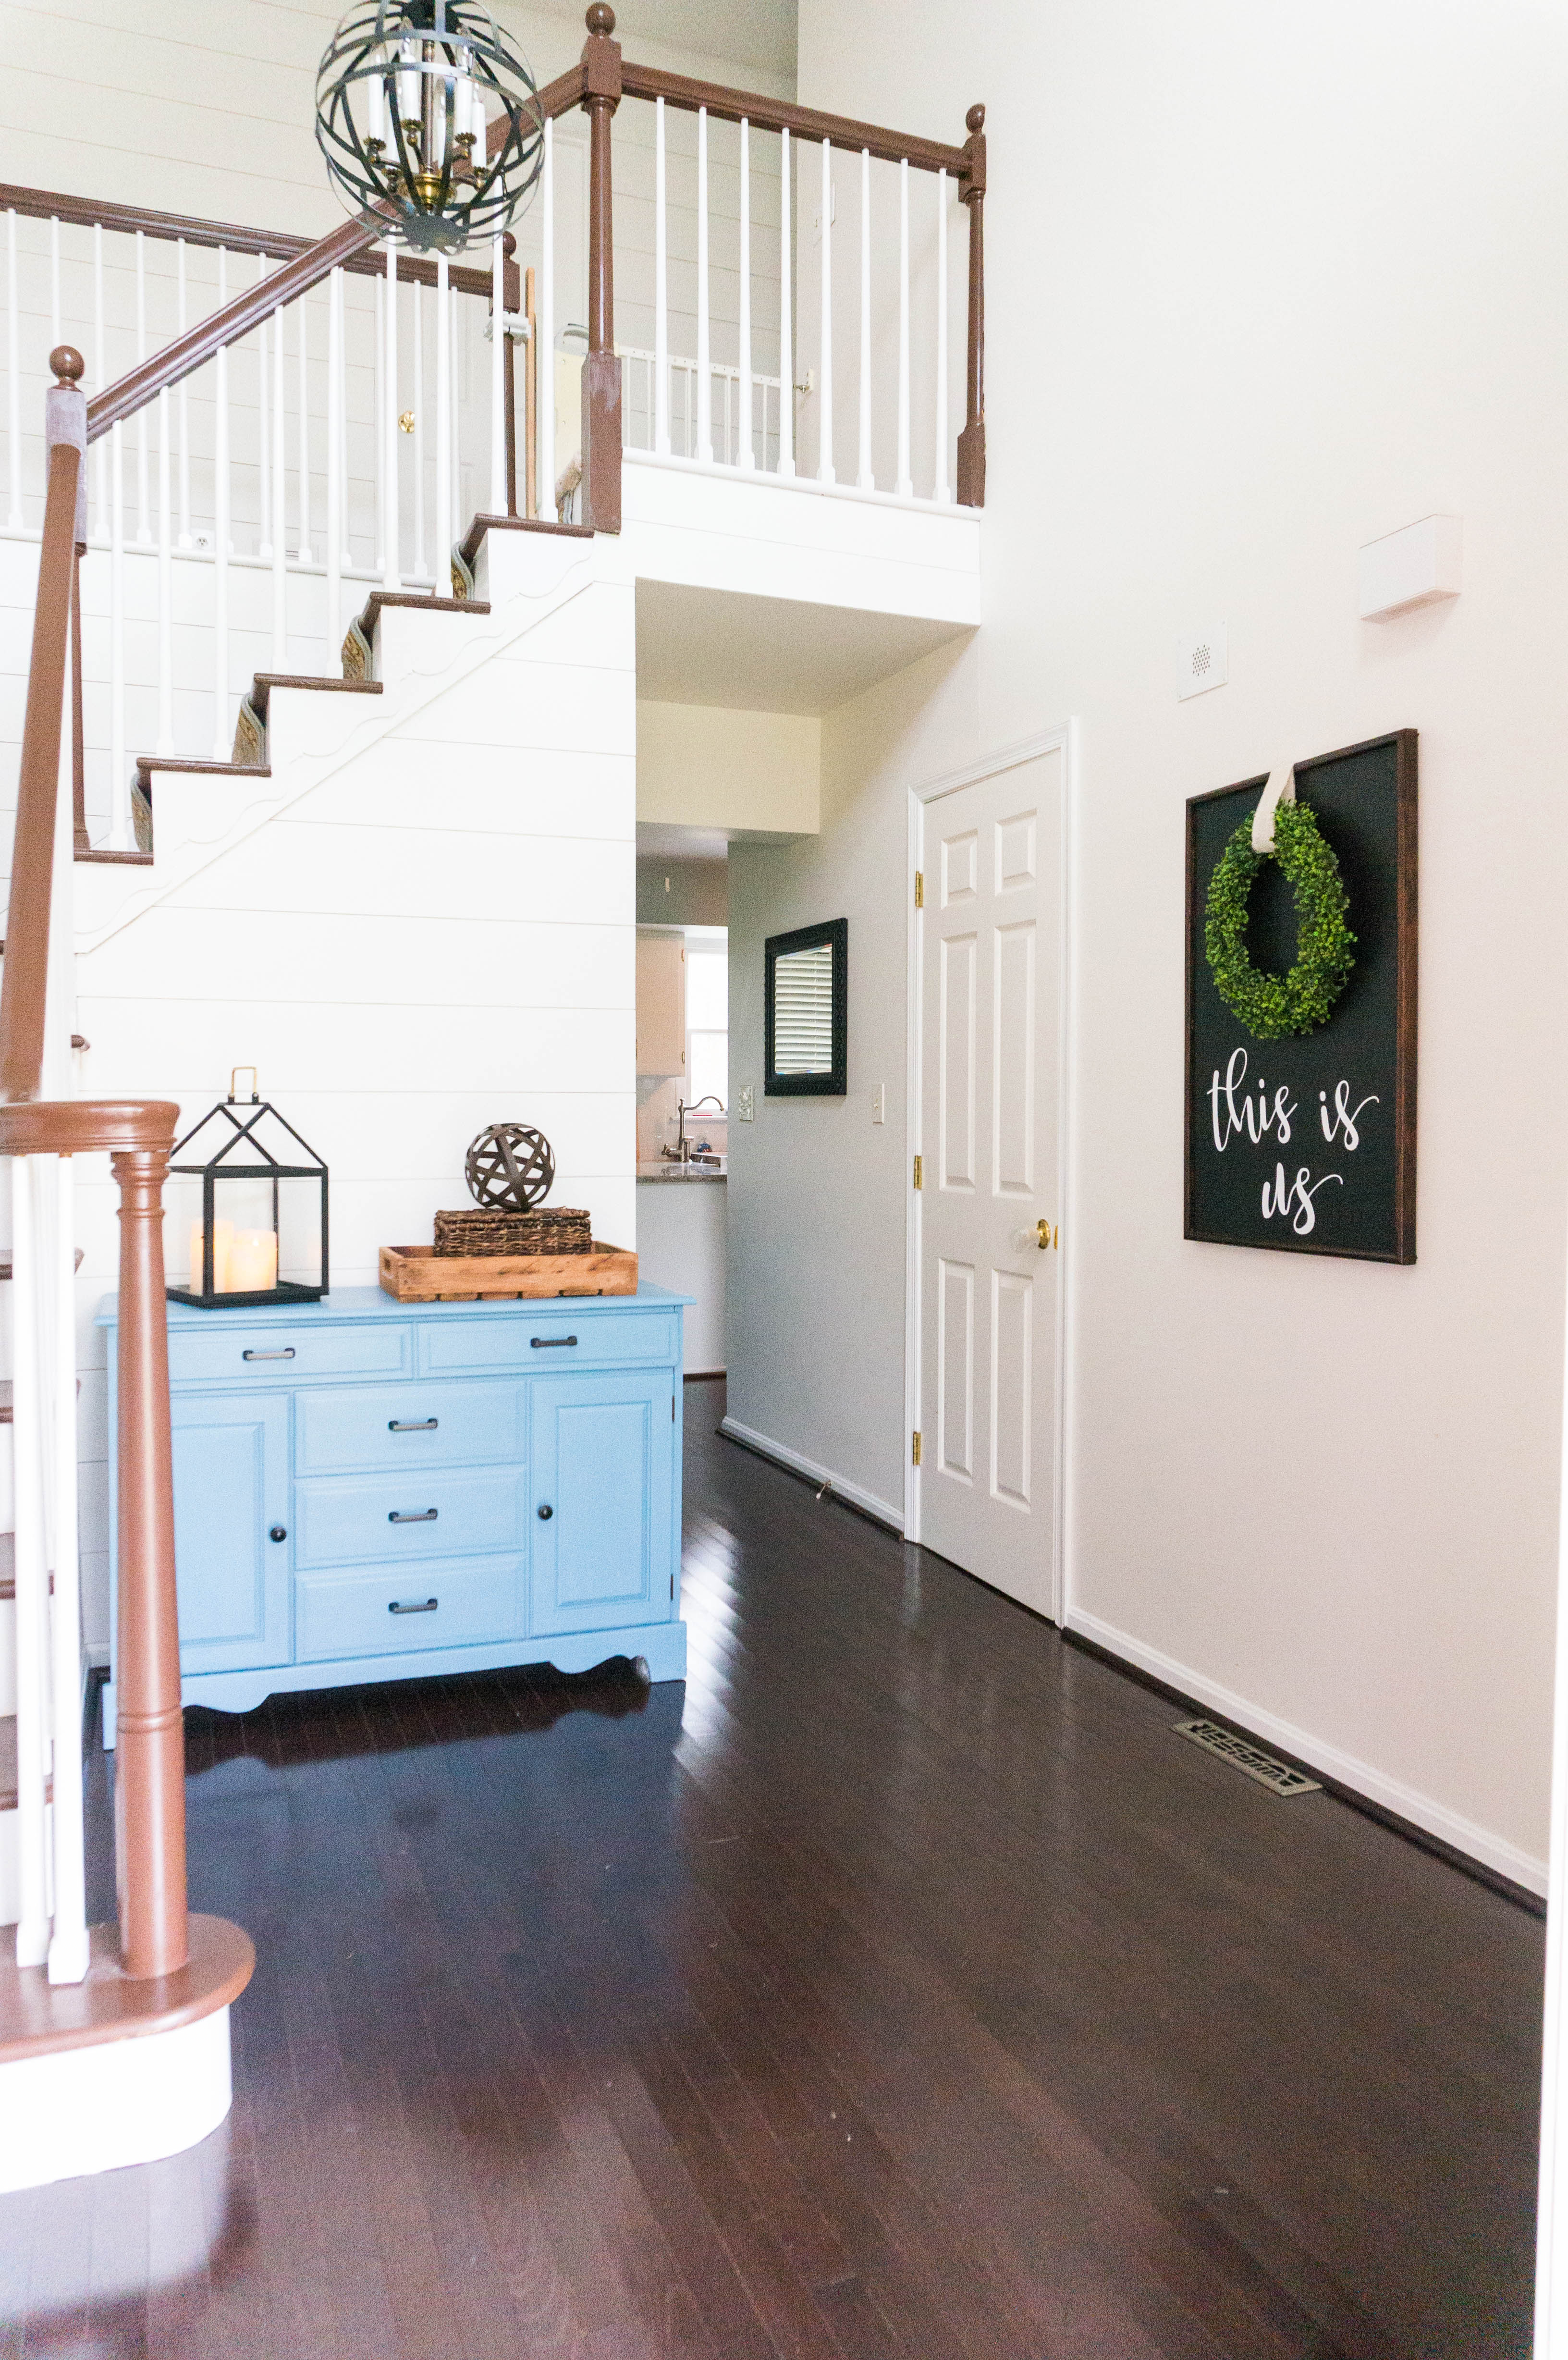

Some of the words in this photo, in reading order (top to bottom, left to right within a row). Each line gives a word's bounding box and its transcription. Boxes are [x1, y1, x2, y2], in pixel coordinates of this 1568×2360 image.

[1207, 1047, 1298, 1152] this
[1320, 1080, 1379, 1151] is
[1262, 1162, 1343, 1235] us
